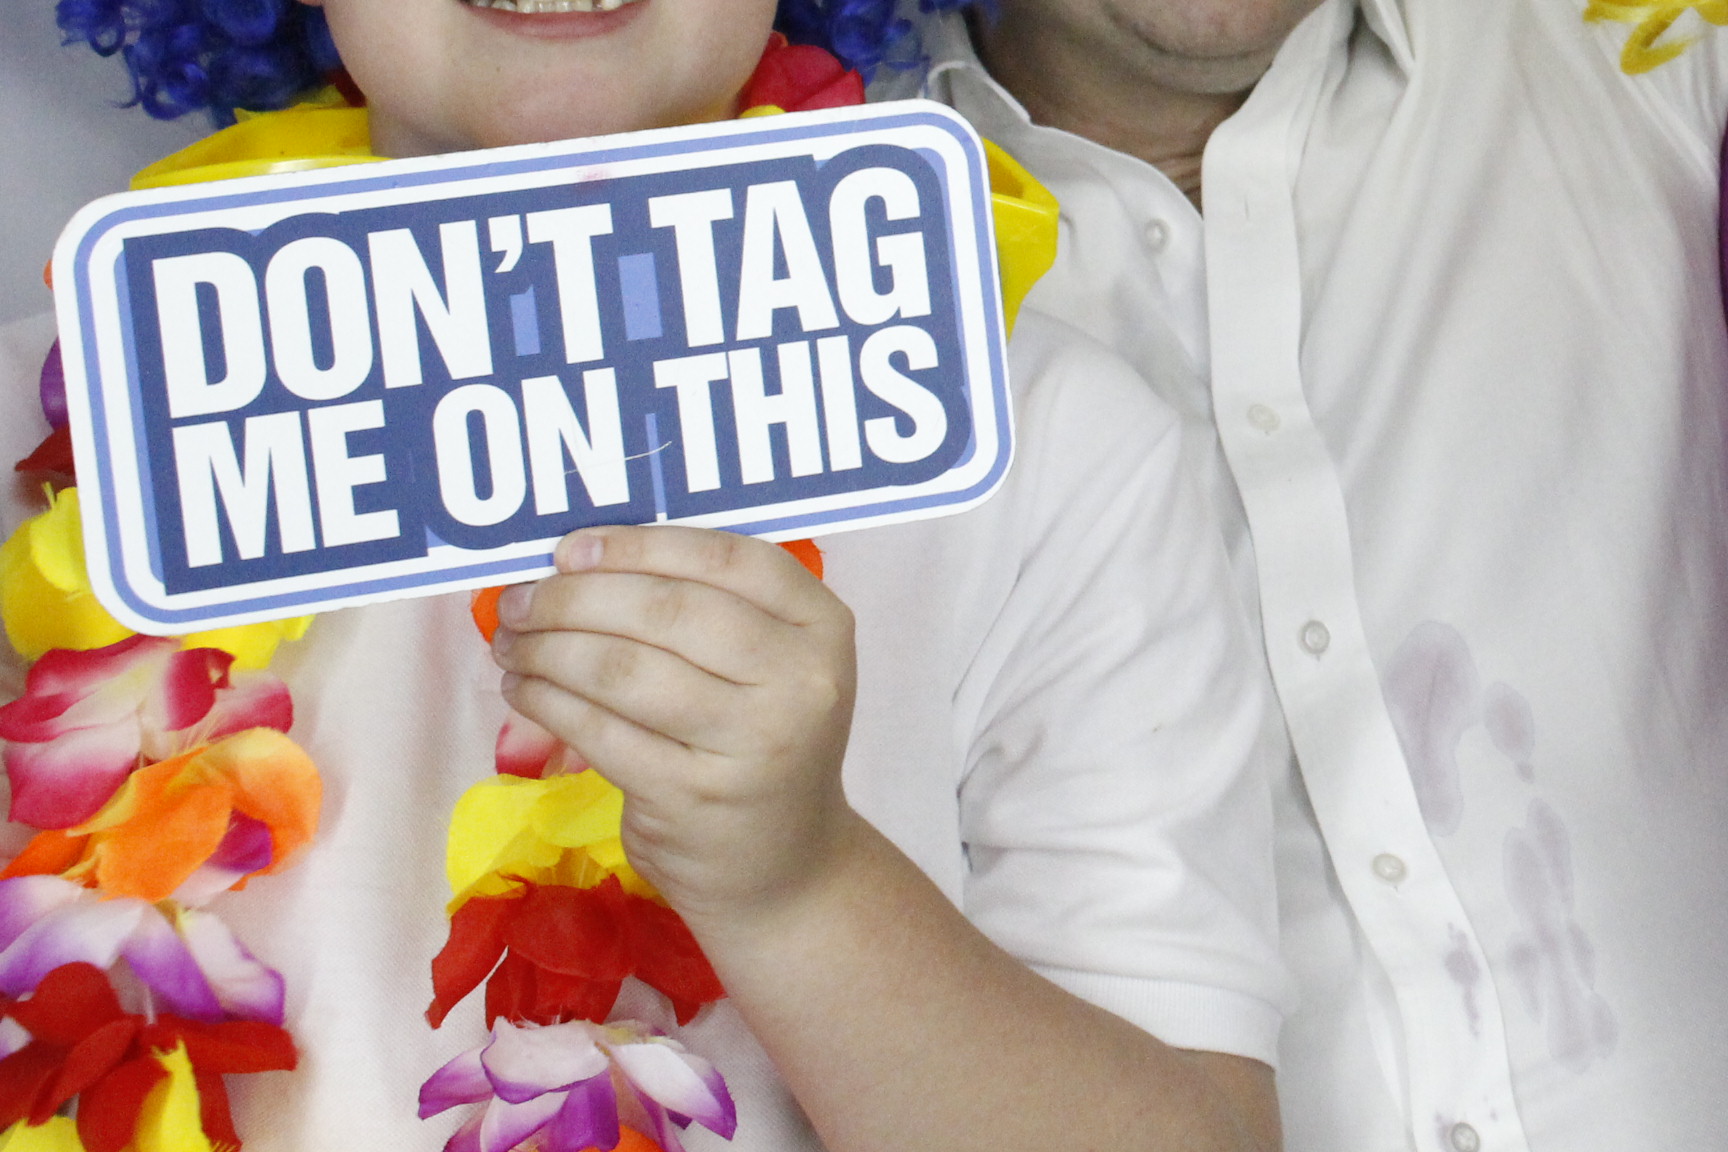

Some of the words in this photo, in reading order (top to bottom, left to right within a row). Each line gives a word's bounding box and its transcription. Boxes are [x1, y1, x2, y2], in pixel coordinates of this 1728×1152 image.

[151, 203, 613, 419] DON'T
[650, 165, 932, 349] TAG
[171, 400, 400, 568] ME
[432, 367, 629, 527] ON
[654, 325, 947, 494] THIS
